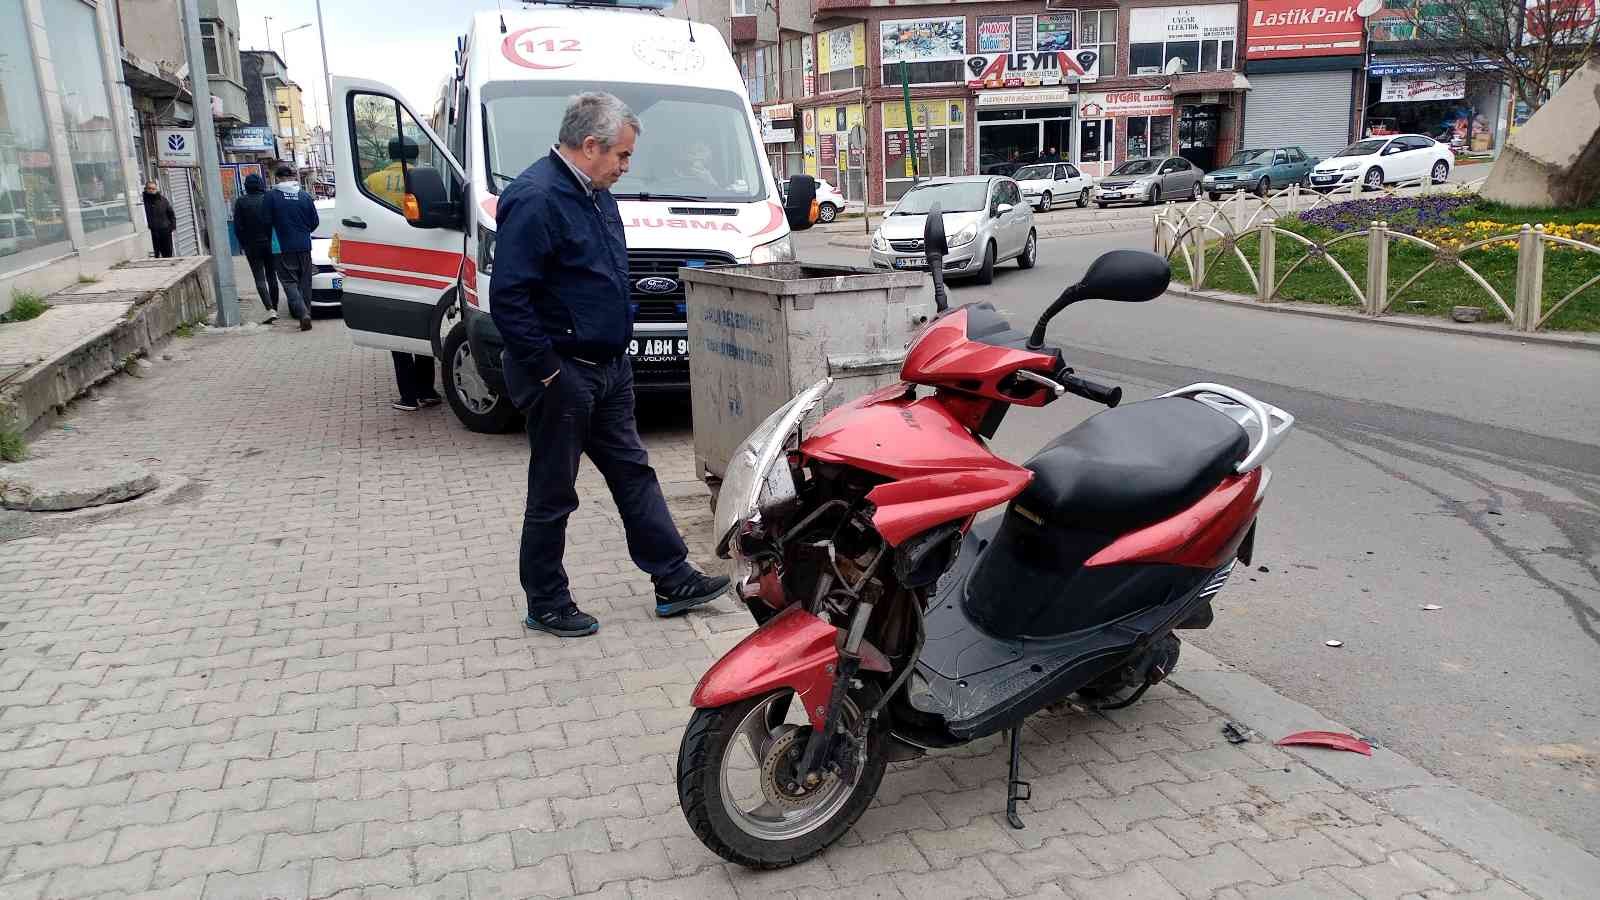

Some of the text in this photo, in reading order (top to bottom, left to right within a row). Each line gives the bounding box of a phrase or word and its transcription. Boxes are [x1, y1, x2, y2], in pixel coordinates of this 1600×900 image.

[1253, 6, 1356, 27] LastikPark
[518, 39, 583, 53] 112
[644, 339, 673, 356] ABH
[677, 339, 689, 355] 9
